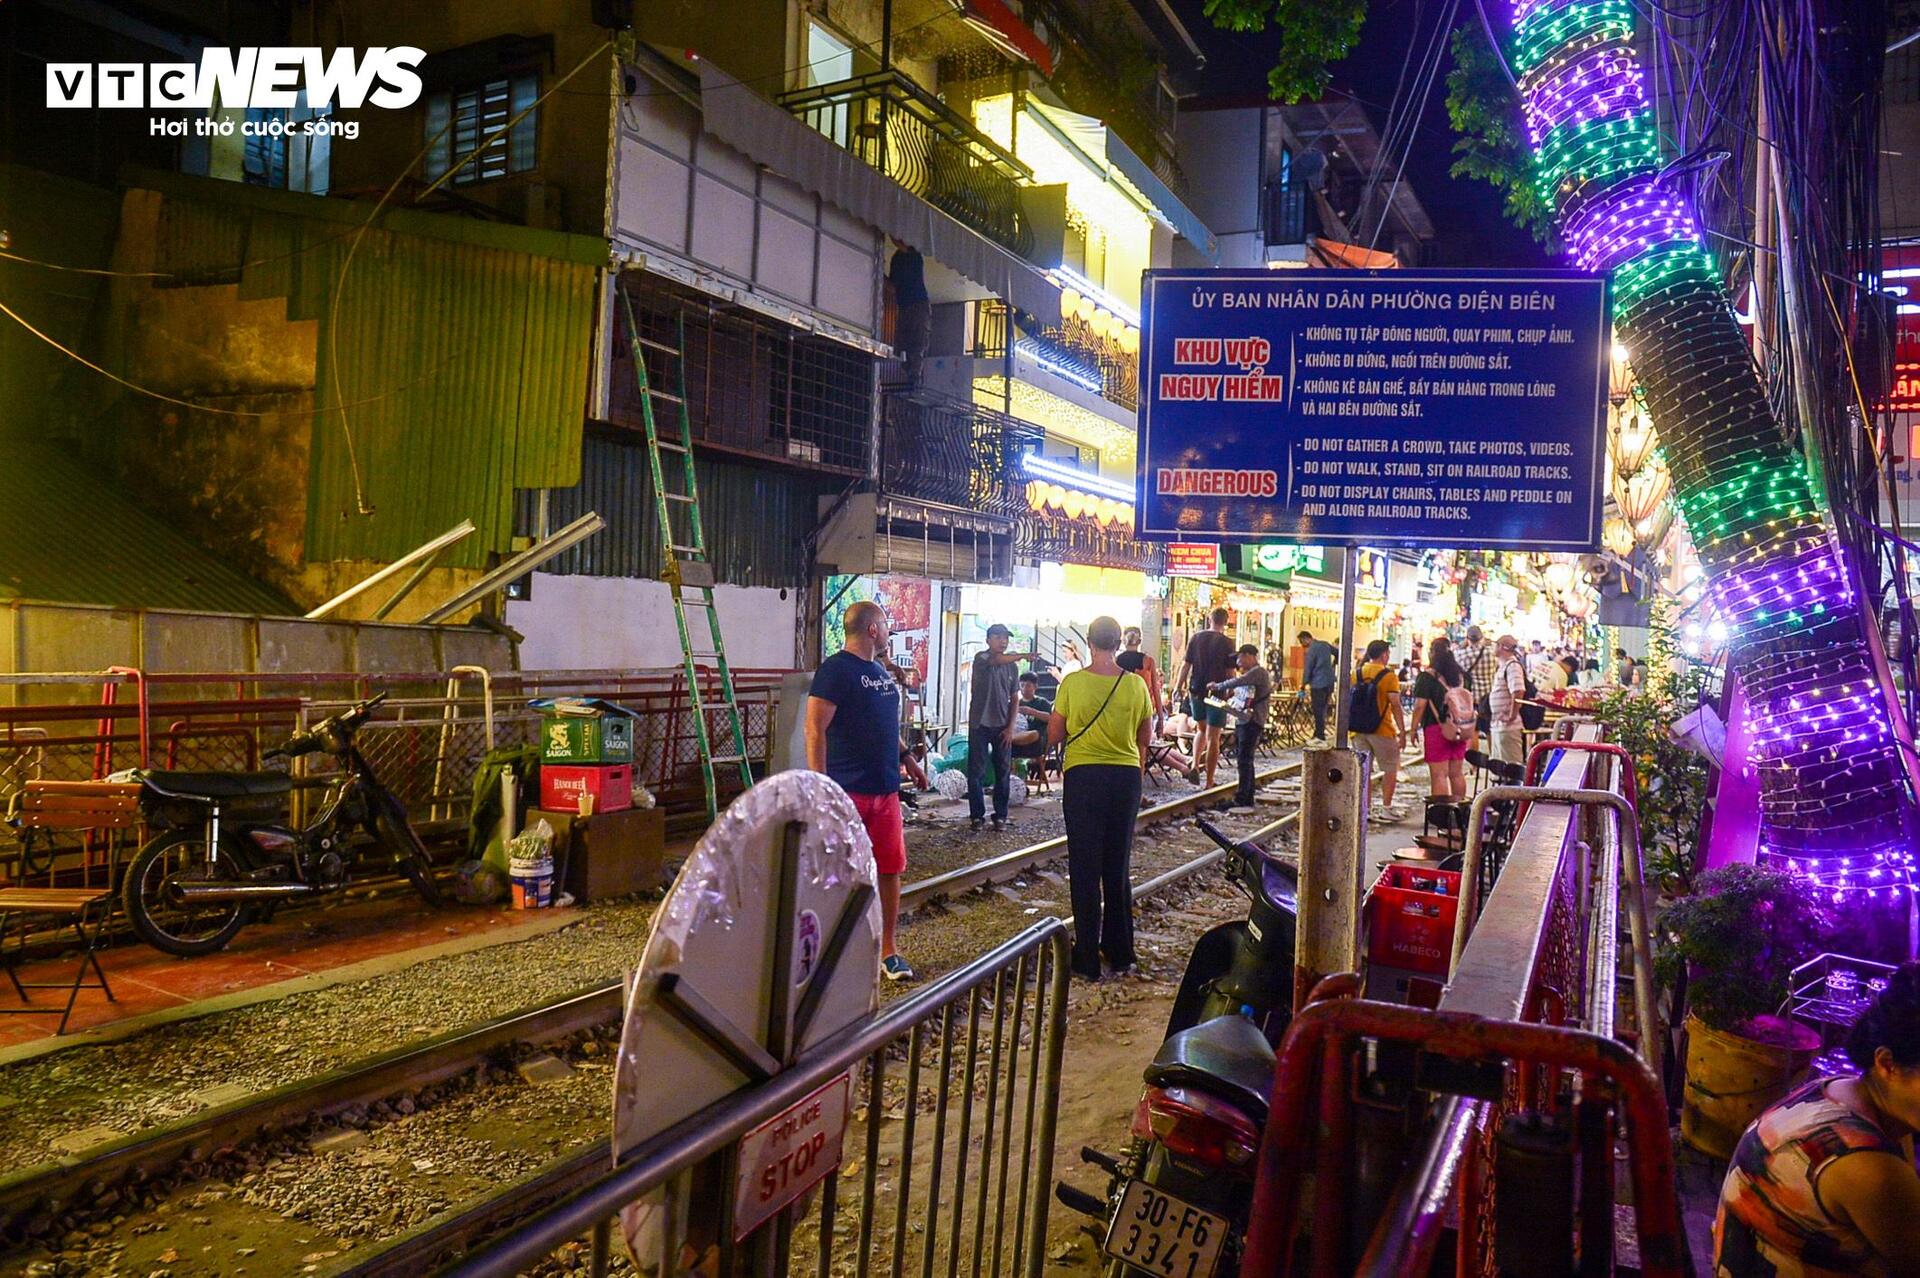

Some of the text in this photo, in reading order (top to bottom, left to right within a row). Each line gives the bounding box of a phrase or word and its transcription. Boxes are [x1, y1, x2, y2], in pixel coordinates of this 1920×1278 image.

[1192, 286, 1555, 313] ỦY BAN NHÂN DÂN PHƯỜNG ĐIỆN BIÊN
[1306, 324, 1342, 341] KHÔNG
[1345, 327, 1358, 344] TỤ
[1361, 325, 1380, 344] TẬP
[1383, 325, 1412, 342] ĐÔNG
[1453, 328, 1481, 344] QUAY
[1483, 329, 1515, 344] PHIM,
[1517, 329, 1546, 346] CHỤP
[1548, 324, 1575, 343] ẢNH.
[1174, 336, 1271, 370] KHU VỰC
[1305, 351, 1341, 368] KHÔNG
[1343, 354, 1354, 368] ĐI
[1420, 352, 1447, 369] TRÊN
[1449, 352, 1486, 369] ĐƯỜNG
[1159, 367, 1283, 402] NGUY HIỂM
[1304, 377, 1340, 394] KHÔNG
[1342, 378, 1356, 394] KÊ
[1490, 382, 1525, 397] TRONG
[1302, 399, 1316, 416] VÀ
[1318, 402, 1336, 416] HAI
[1338, 400, 1360, 416] BÊN
[1362, 400, 1398, 417] ĐƯỜNG
[1304, 438, 1574, 456] DO NOT GATHER A CROWD, TAKE PHOTOS, VIDEOS.
[1304, 461, 1572, 480] DO NOT WALK, STAND, SIT ON RAILROAD TRACKS.
[1156, 468, 1278, 497] DANGEROUS
[1301, 485, 1572, 504] DO NOT DISPLAY CHAIRS, TABLES AND PEDDLE ON
[1302, 503, 1471, 520] AND ALONG RAILROAD TRACKS.
[546, 749, 572, 758] SAIGON
[605, 740, 629, 750] SAIGON
[1392, 943, 1441, 959] HABECO
[771, 1100, 822, 1148] POLICE
[760, 1131, 826, 1203] STOP
[1122, 1223, 1200, 1278] 3341
